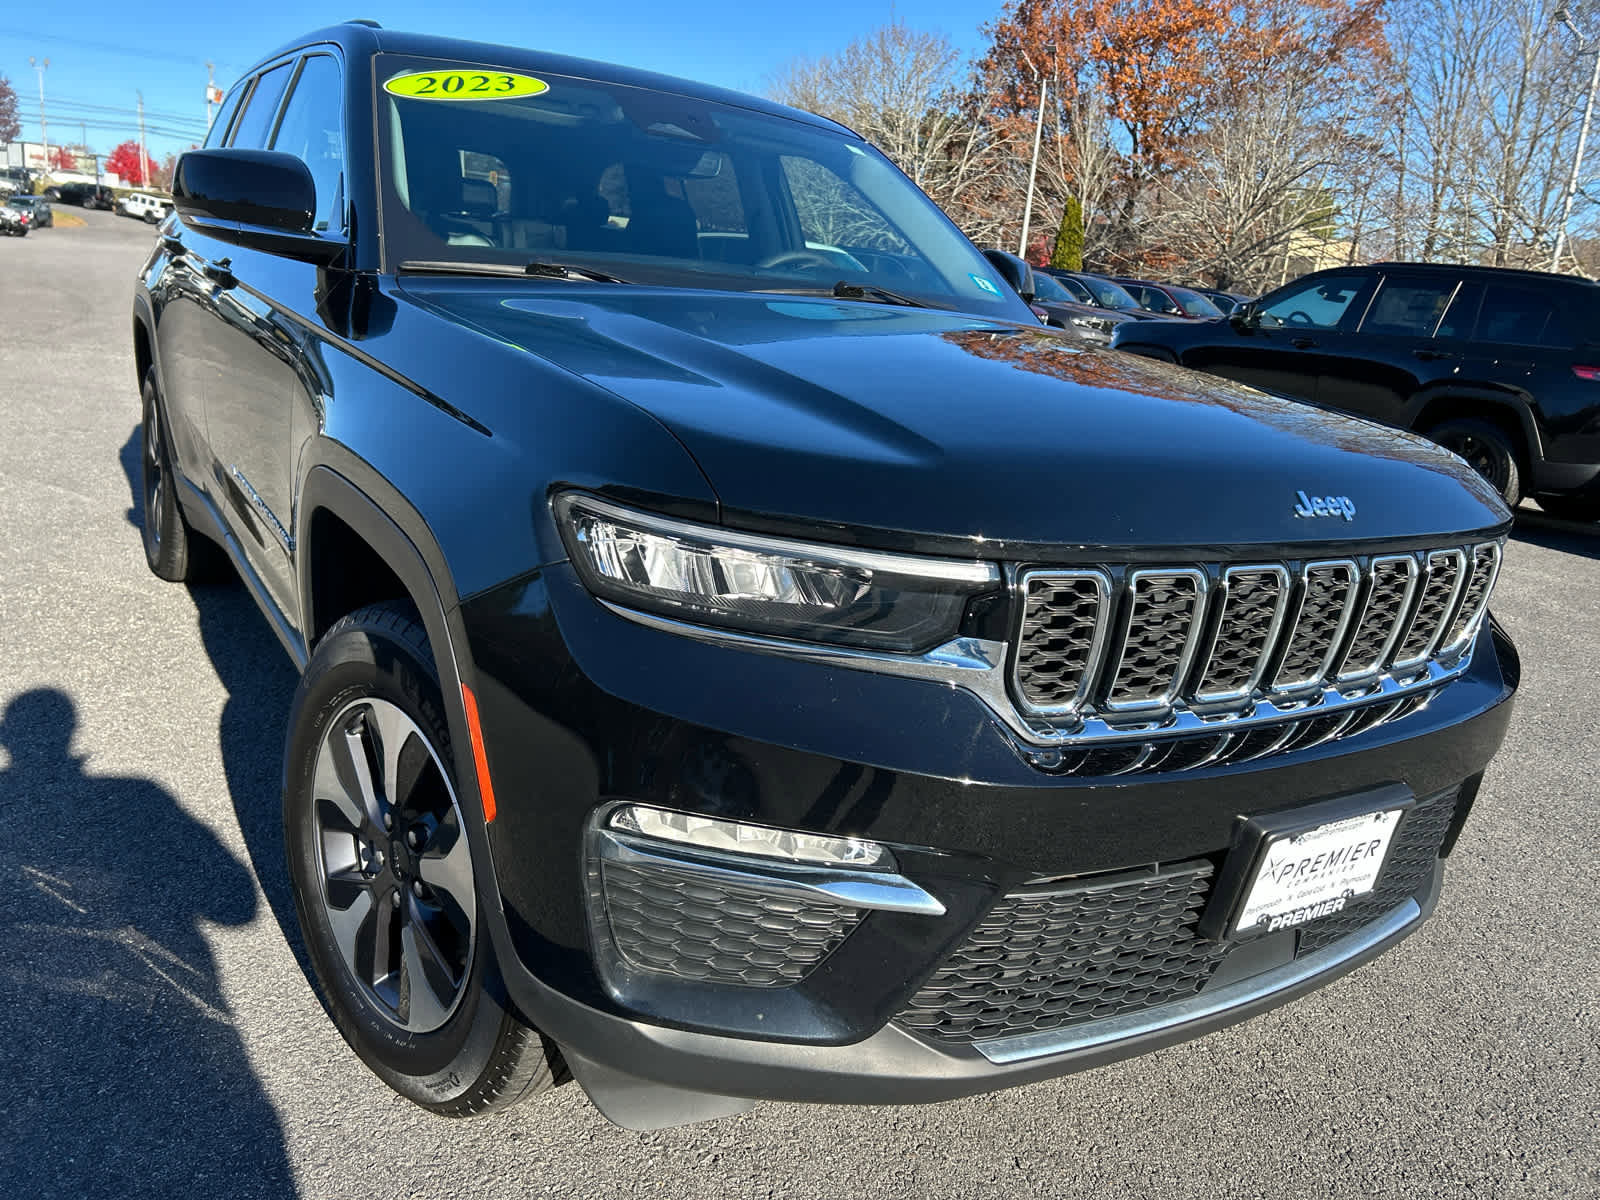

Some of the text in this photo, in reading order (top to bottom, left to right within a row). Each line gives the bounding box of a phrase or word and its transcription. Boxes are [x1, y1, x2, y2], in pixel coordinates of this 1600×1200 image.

[414, 75, 516, 95] 2023
[1294, 490, 1357, 522] Jeep
[1276, 839, 1382, 884] PREMIER
[1268, 898, 1347, 932] PREMIER
